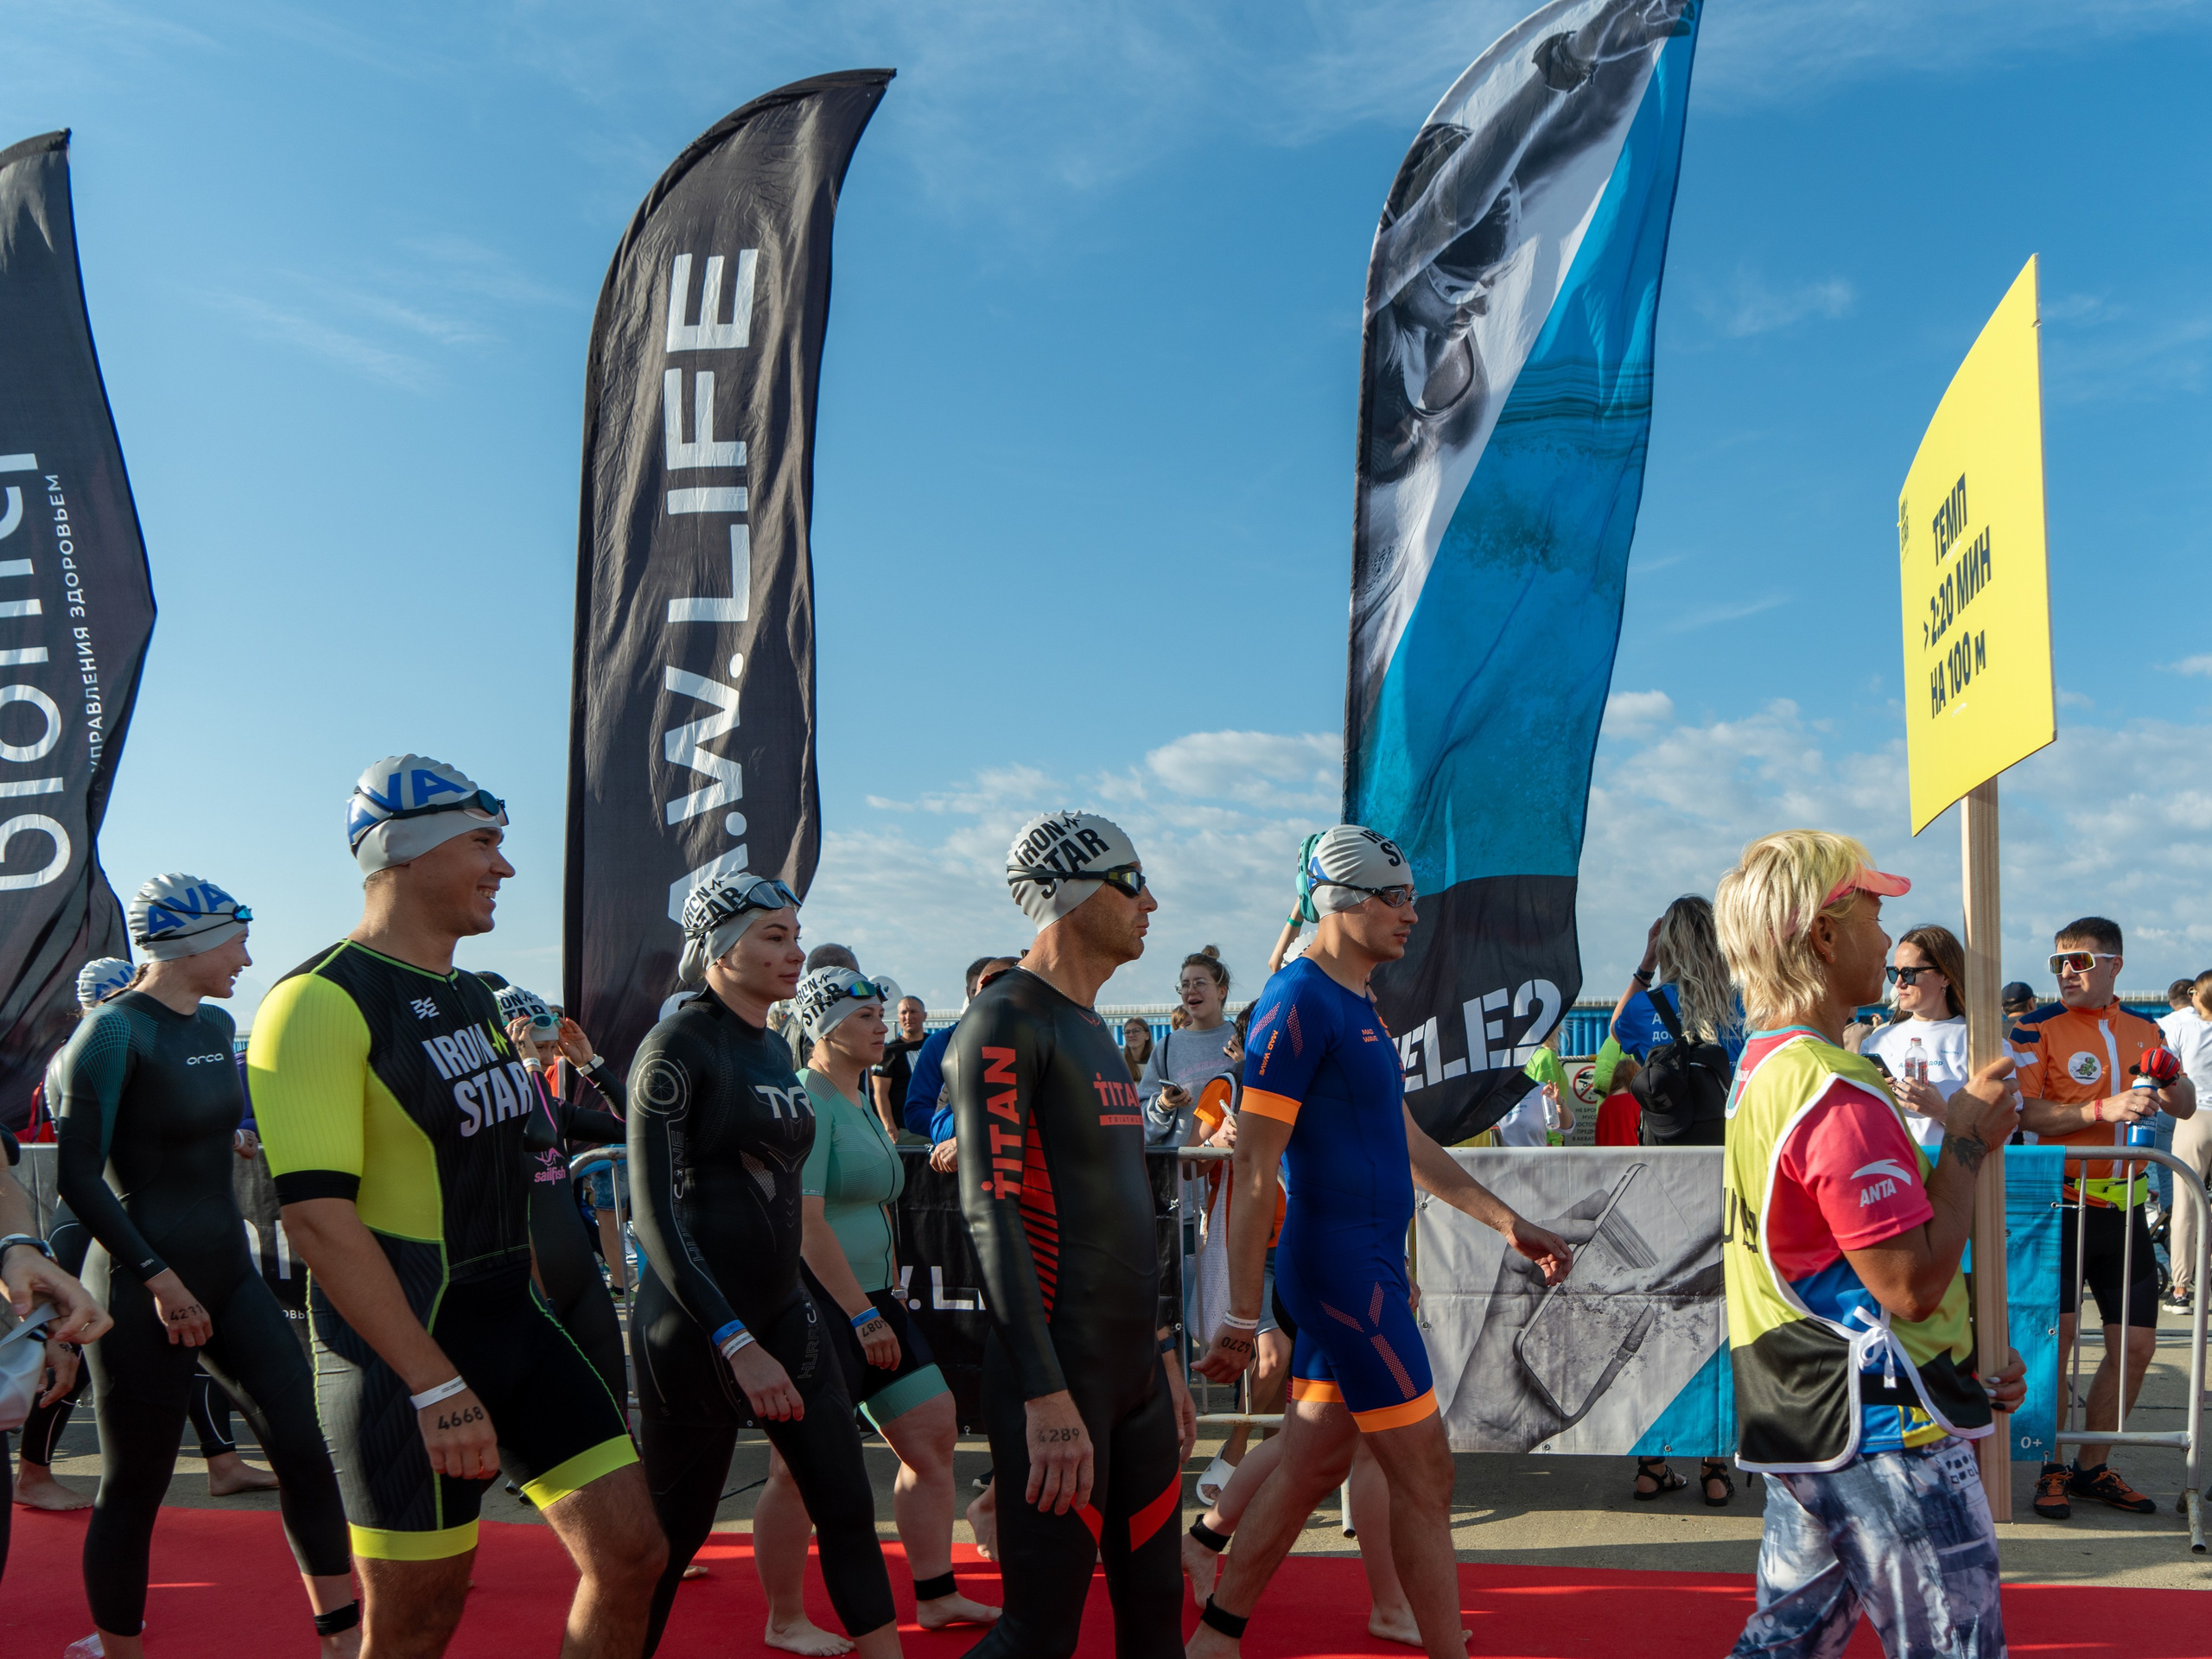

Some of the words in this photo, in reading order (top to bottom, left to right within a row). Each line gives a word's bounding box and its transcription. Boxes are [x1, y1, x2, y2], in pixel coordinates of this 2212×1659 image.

[1932, 471, 1967, 567] ТЕМП
[45, 474, 86, 618] ЗДОРОВЬЕМ
[1930, 572, 1954, 648] 2:20
[1956, 524, 1992, 615] МИН
[1930, 659, 1947, 720] НА
[1948, 631, 1971, 699] 100
[1014, 820, 1067, 866] IRON
[148, 883, 234, 936] AVA
[187, 1052, 224, 1065] orca
[422, 1023, 499, 1080] IRON
[1268, 1030, 1279, 1050] MAD
[1392, 979, 1561, 1093] ELE2
[1259, 1052, 1271, 1076] WAVE
[453, 1061, 534, 1137] STAR
[755, 1085, 815, 1118] TYR
[981, 1046, 1022, 1199] TITAN
[534, 1166, 566, 1185] sailfish
[1859, 1178, 1897, 1208] ANTA
[438, 1406, 484, 1430] 4668
[2020, 1436, 2043, 1449] 0+
